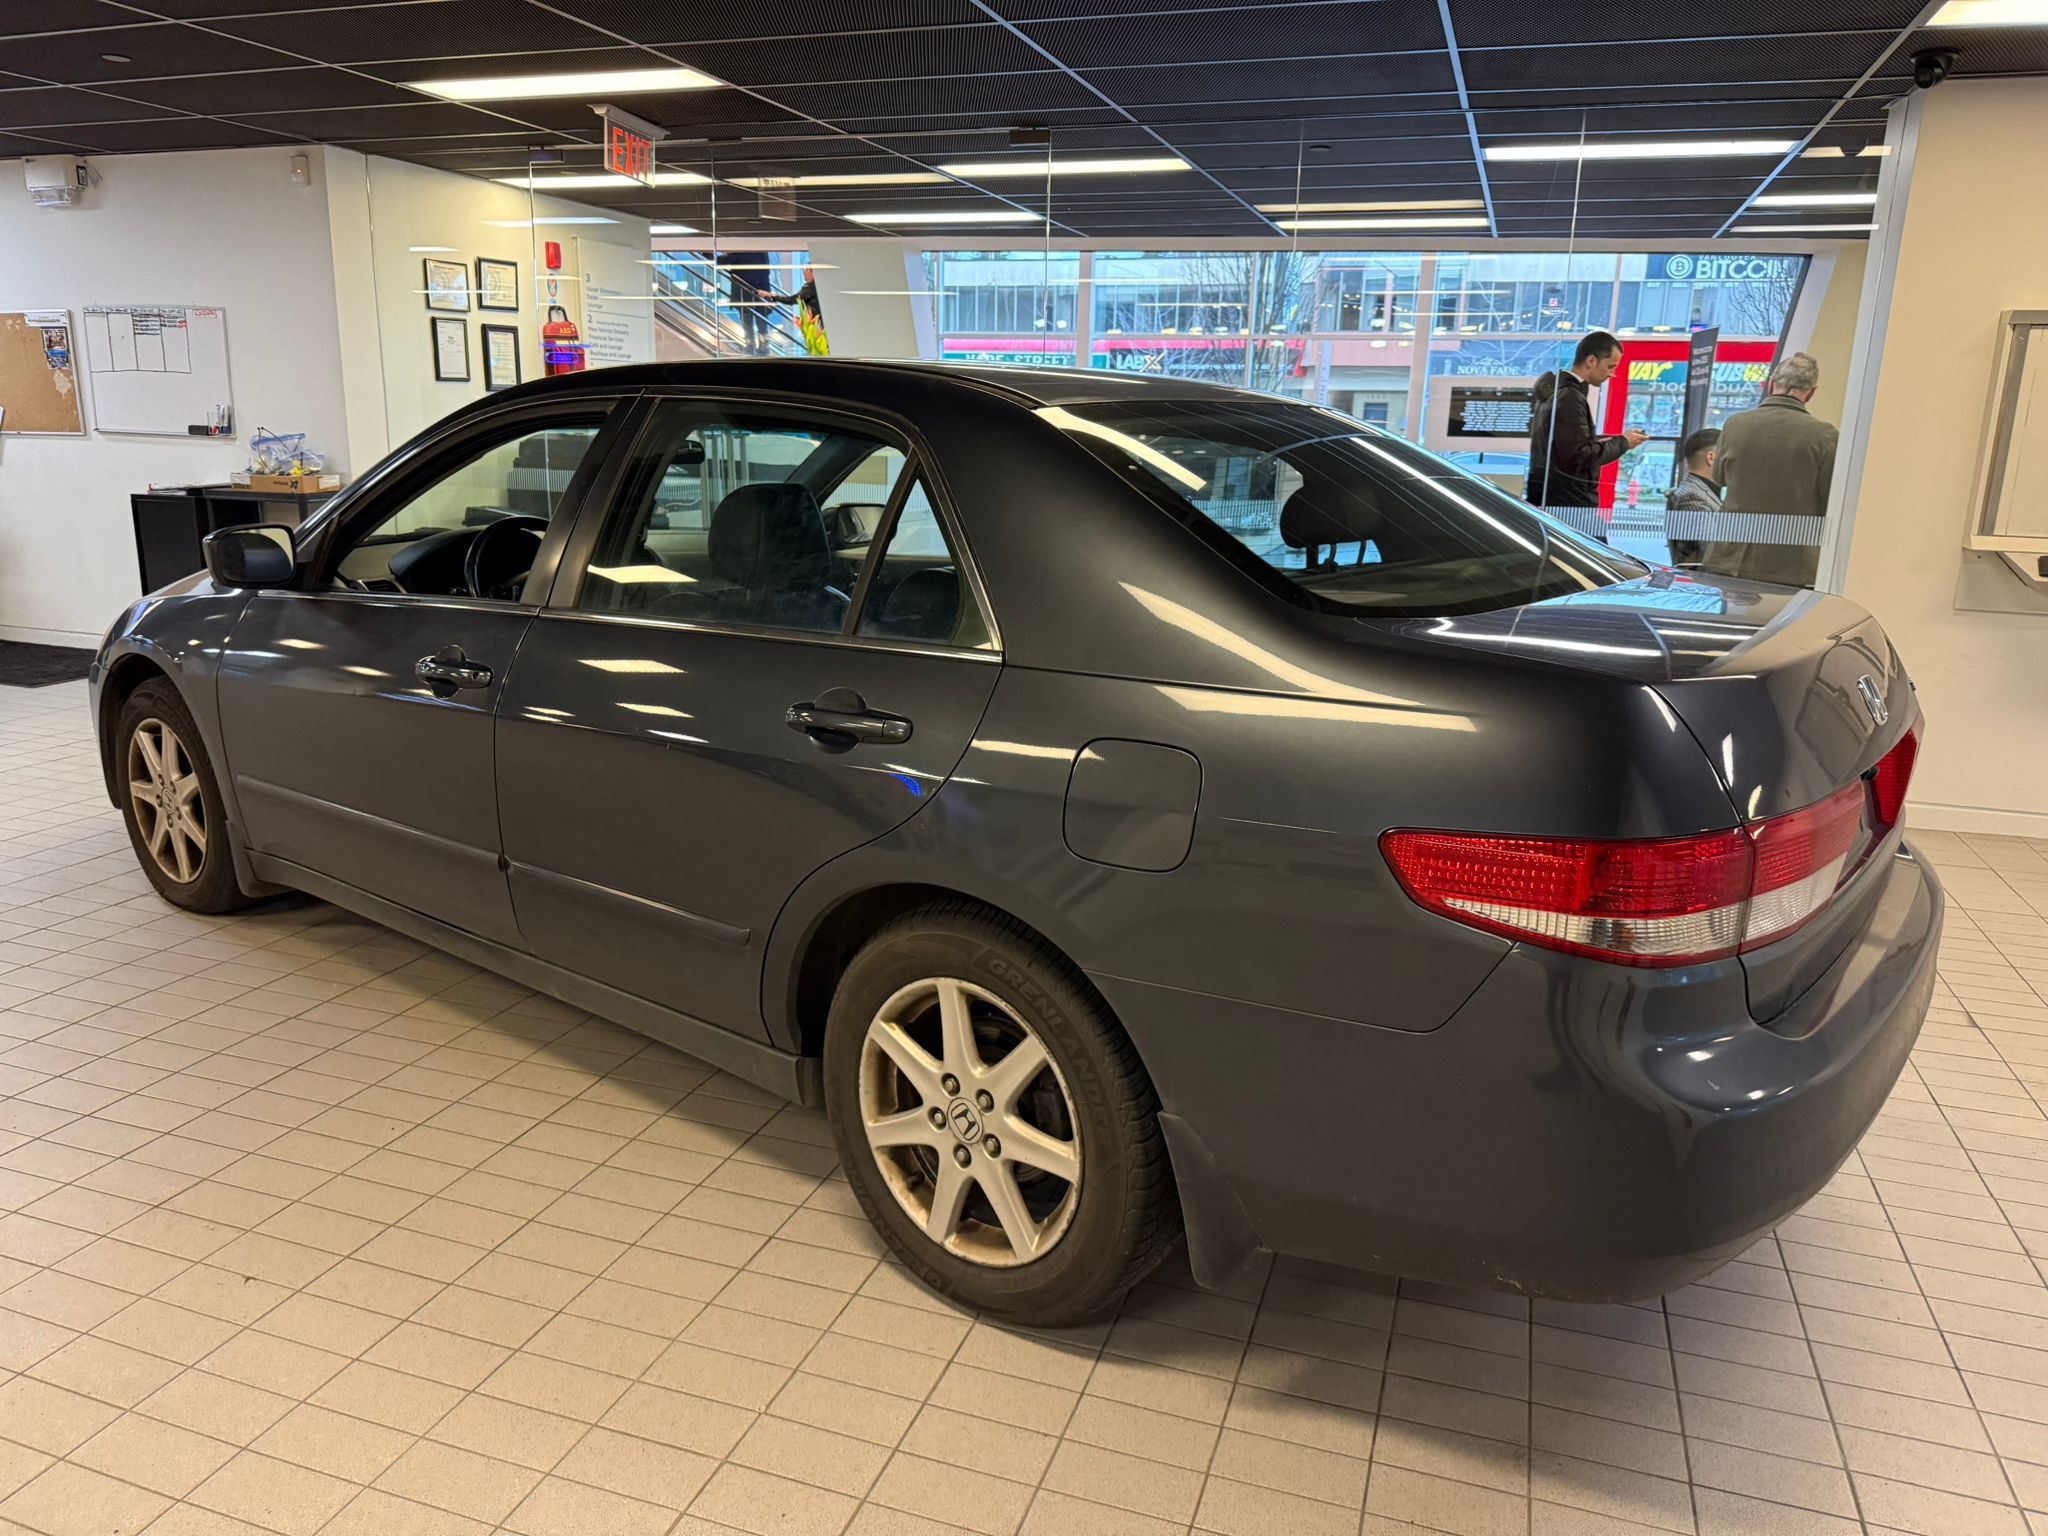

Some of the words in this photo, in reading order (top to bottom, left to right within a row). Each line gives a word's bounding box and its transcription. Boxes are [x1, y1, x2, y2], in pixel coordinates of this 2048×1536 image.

[612, 126, 652, 182] EXIT
[585, 273, 591, 283] 3
[588, 314, 593, 323] 2
